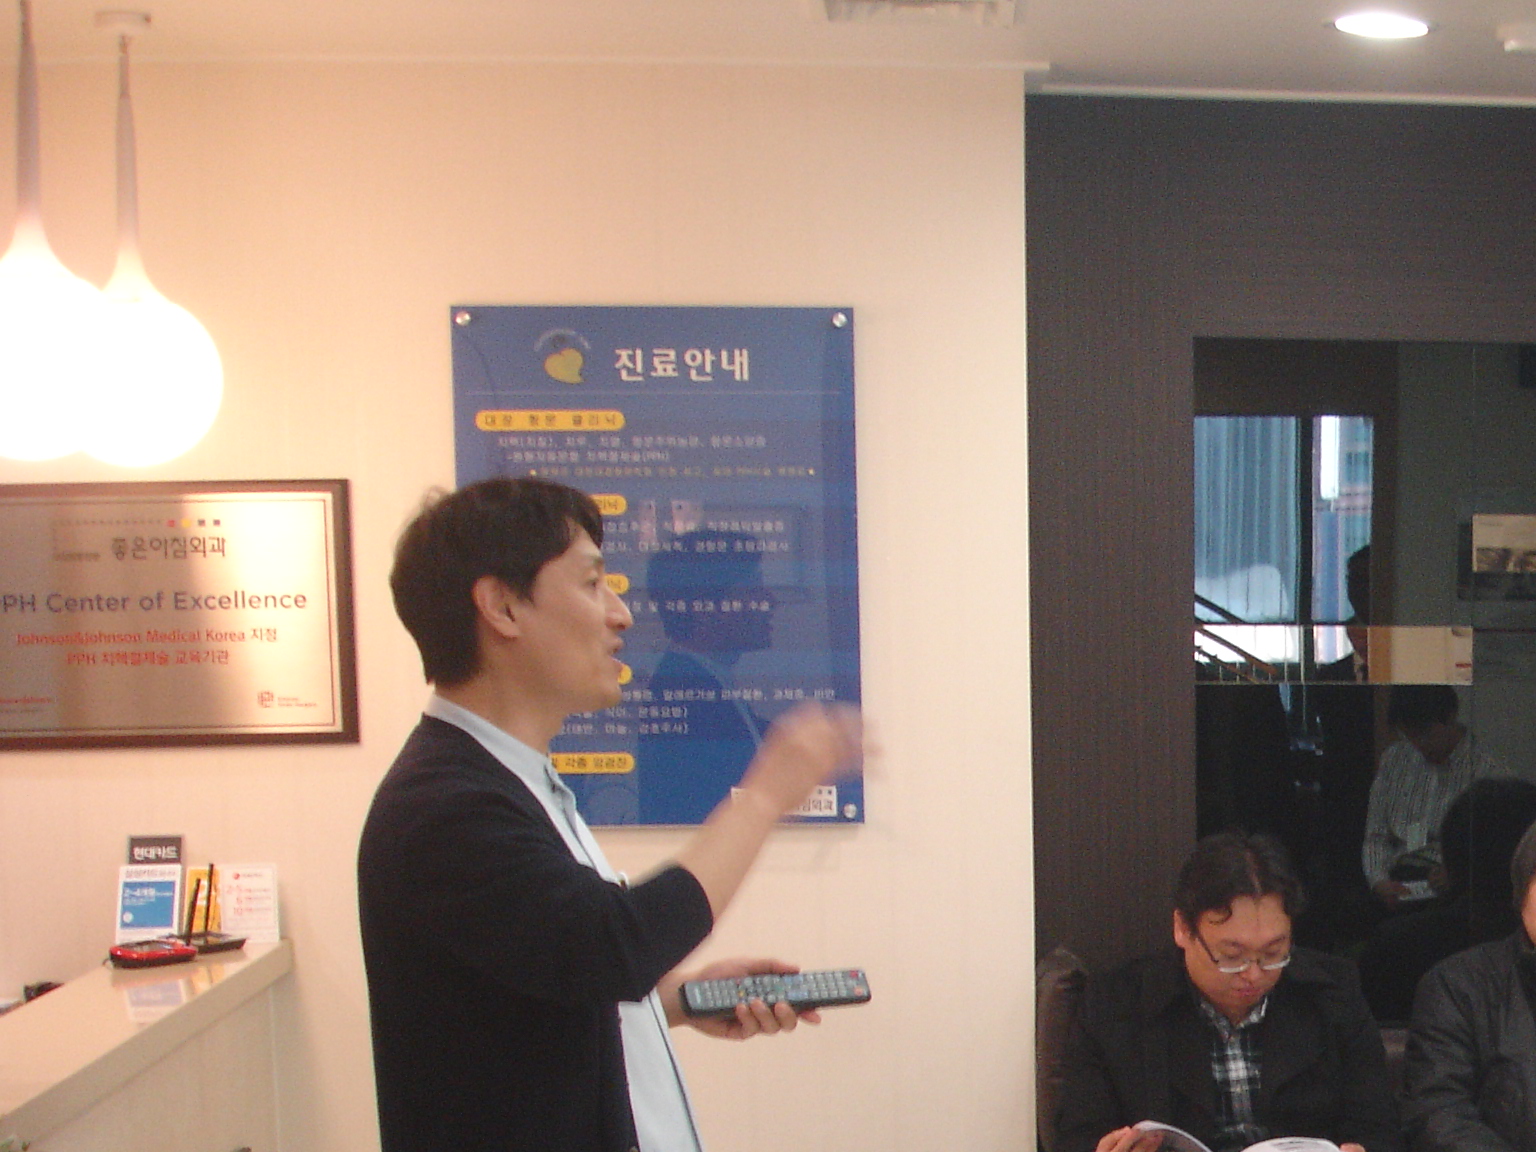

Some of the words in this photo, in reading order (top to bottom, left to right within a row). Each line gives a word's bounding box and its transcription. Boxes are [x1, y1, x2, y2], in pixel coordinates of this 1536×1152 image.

[614, 347, 750, 382] 진료안내
[46, 593, 130, 613] Center
[139, 591, 164, 611] of
[174, 590, 307, 610] Excellence
[147, 629, 201, 643] Medical
[206, 628, 246, 642] Korea
[250, 627, 277, 642] 지정
[133, 846, 178, 860] 현대카드
